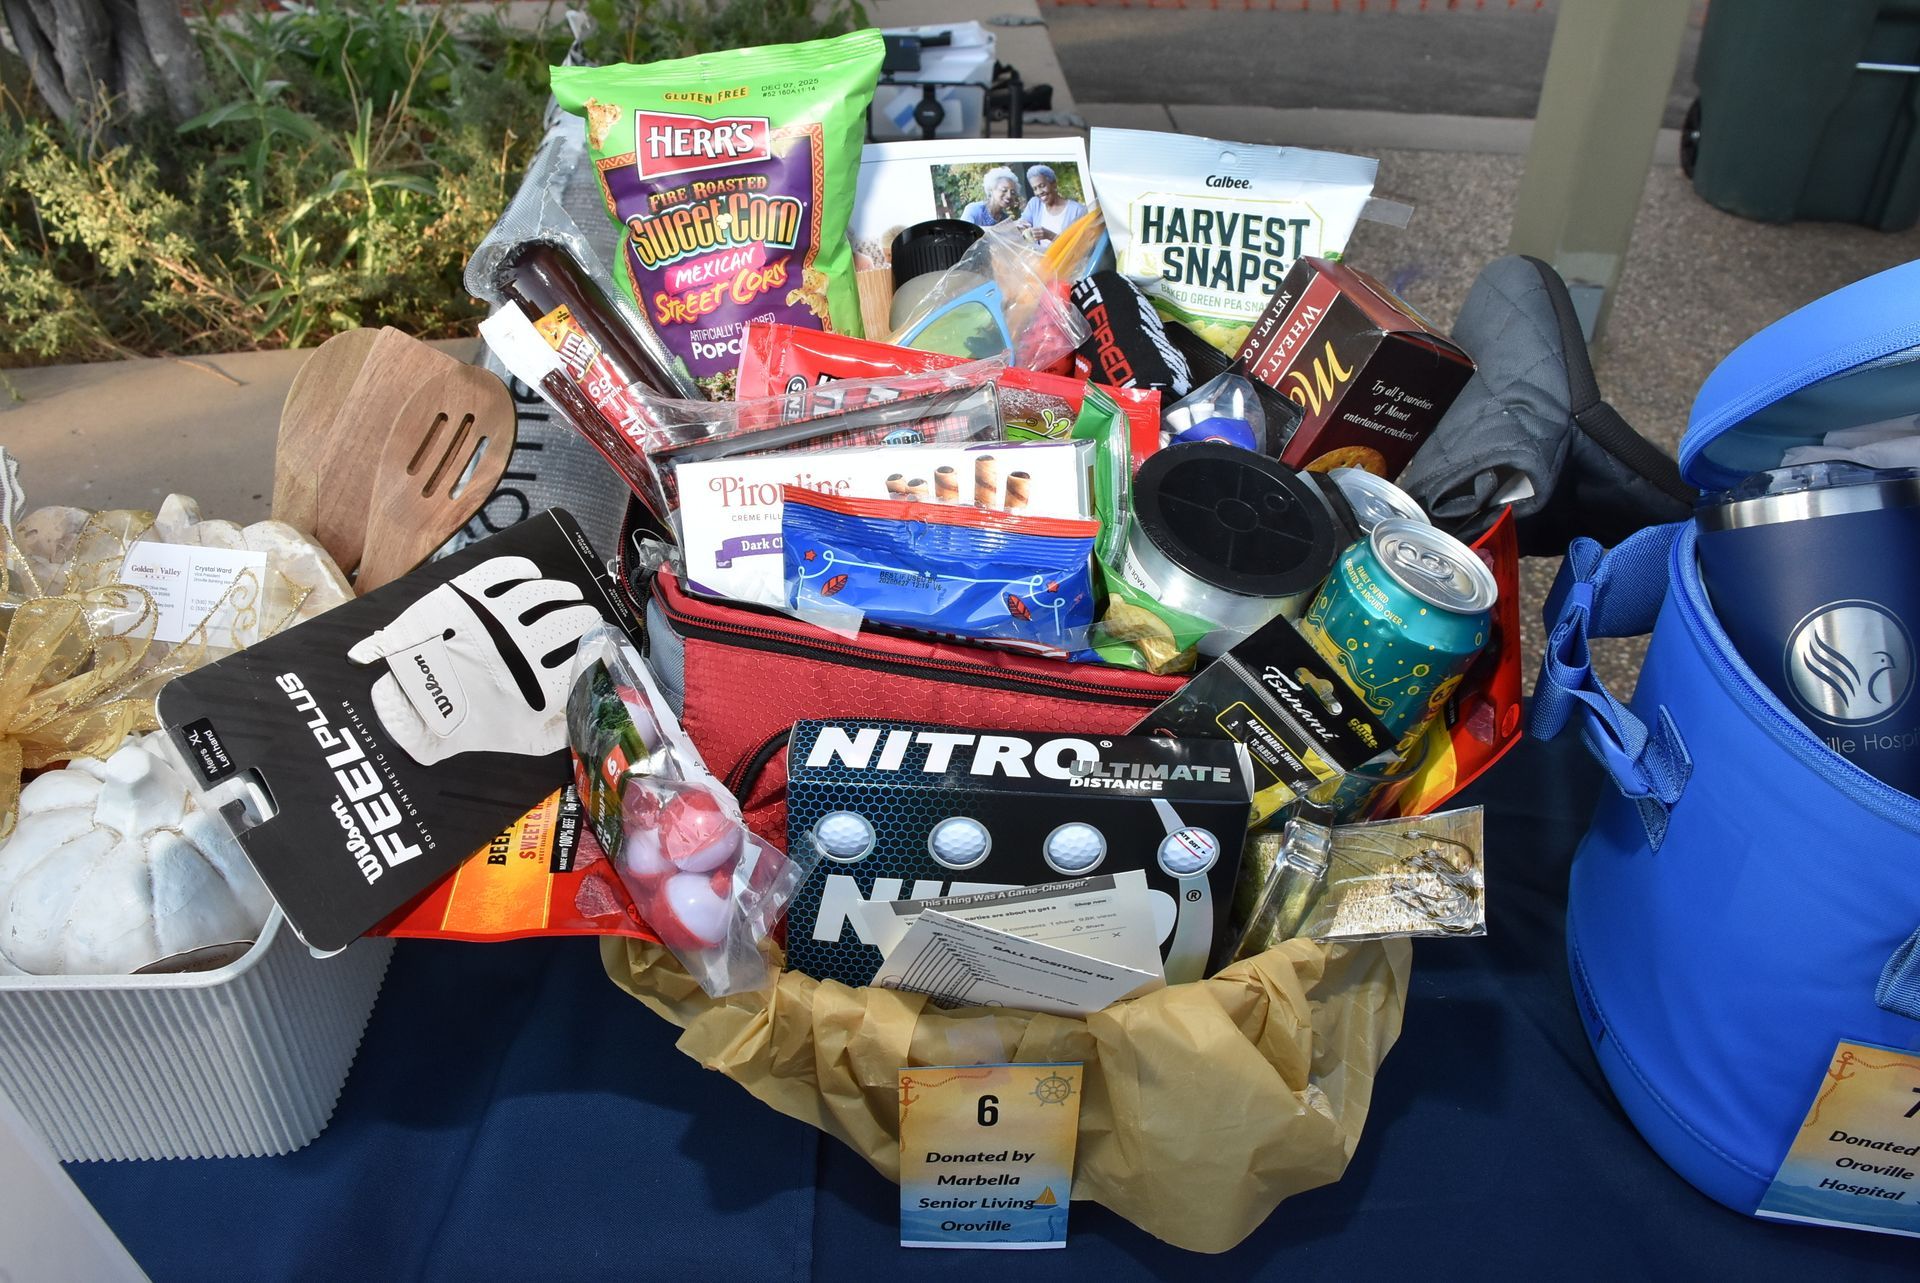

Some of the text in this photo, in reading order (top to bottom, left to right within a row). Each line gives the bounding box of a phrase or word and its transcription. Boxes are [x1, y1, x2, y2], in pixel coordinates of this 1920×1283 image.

[665, 88, 747, 104] GLUTEN FREE
[646, 122, 754, 158] HERR'S
[649, 176, 767, 212] FIRE ROASTED
[1205, 175, 1249, 189] Calbee
[1141, 204, 1310, 259] HARVEST
[675, 247, 755, 288] MEXICAN
[1162, 246, 1285, 295] SNAPS
[1161, 284, 1188, 302] BAKED
[1190, 292, 1220, 308] GREEN
[1224, 298, 1242, 310] PEA
[1271, 290, 1292, 317] NET
[689, 323, 734, 342] ARTIFICIALLY
[1256, 318, 1279, 338] WT.
[1271, 304, 1323, 373] WHEAT
[1372, 380, 1434, 410] Try all 3 varieties
[1374, 402, 1412, 421] of Monet
[1343, 412, 1419, 442] entertainer crackers!
[741, 538, 770, 552] Dark
[132, 564, 181, 576] Golden Valley
[880, 571, 897, 579] BEST
[907, 574, 926, 582] USED
[1356, 564, 1372, 585] FAMILY
[1344, 557, 1403, 626] OPERATED & ARGUED OVER
[414, 653, 454, 720] Wilson
[188, 728, 218, 775] Men's XL
[203, 729, 230, 769] Left hand
[1246, 717, 1267, 738] BLACK
[1262, 732, 1284, 754] BARREL
[1280, 750, 1304, 774] SWIVEL
[1864, 728, 1920, 752] Hospi
[805, 726, 1099, 780] NITRO
[342, 700, 436, 850] SOFT SYNTHETIC LEATHER
[604, 756, 619, 776] 6
[1069, 760, 1231, 784] ULTIMATE
[1070, 776, 1164, 791] DISTANCE
[526, 811, 540, 821] &
[564, 802, 580, 812] 6g
[562, 817, 575, 829] BEEF
[330, 794, 384, 886] Wilson
[519, 822, 541, 861] SWEET
[559, 828, 574, 848] 100%
[1189, 840, 1200, 850] DIST
[559, 857, 567, 870] MADE
[920, 880, 1088, 908] This Thing Was A Game-Changer.
[992, 945, 1027, 957] BALL
[1029, 955, 1093, 976] POSITION
[977, 1094, 999, 1126] 6
[1829, 1130, 1920, 1157] Donated
[926, 1151, 1036, 1164] Donated by
[1835, 1157, 1914, 1180] Oroville
[937, 1175, 1020, 1186] Marbella
[1818, 1178, 1906, 1200] Hospital
[918, 1198, 1036, 1210] Senior Living
[941, 1220, 1012, 1232] Oroville
